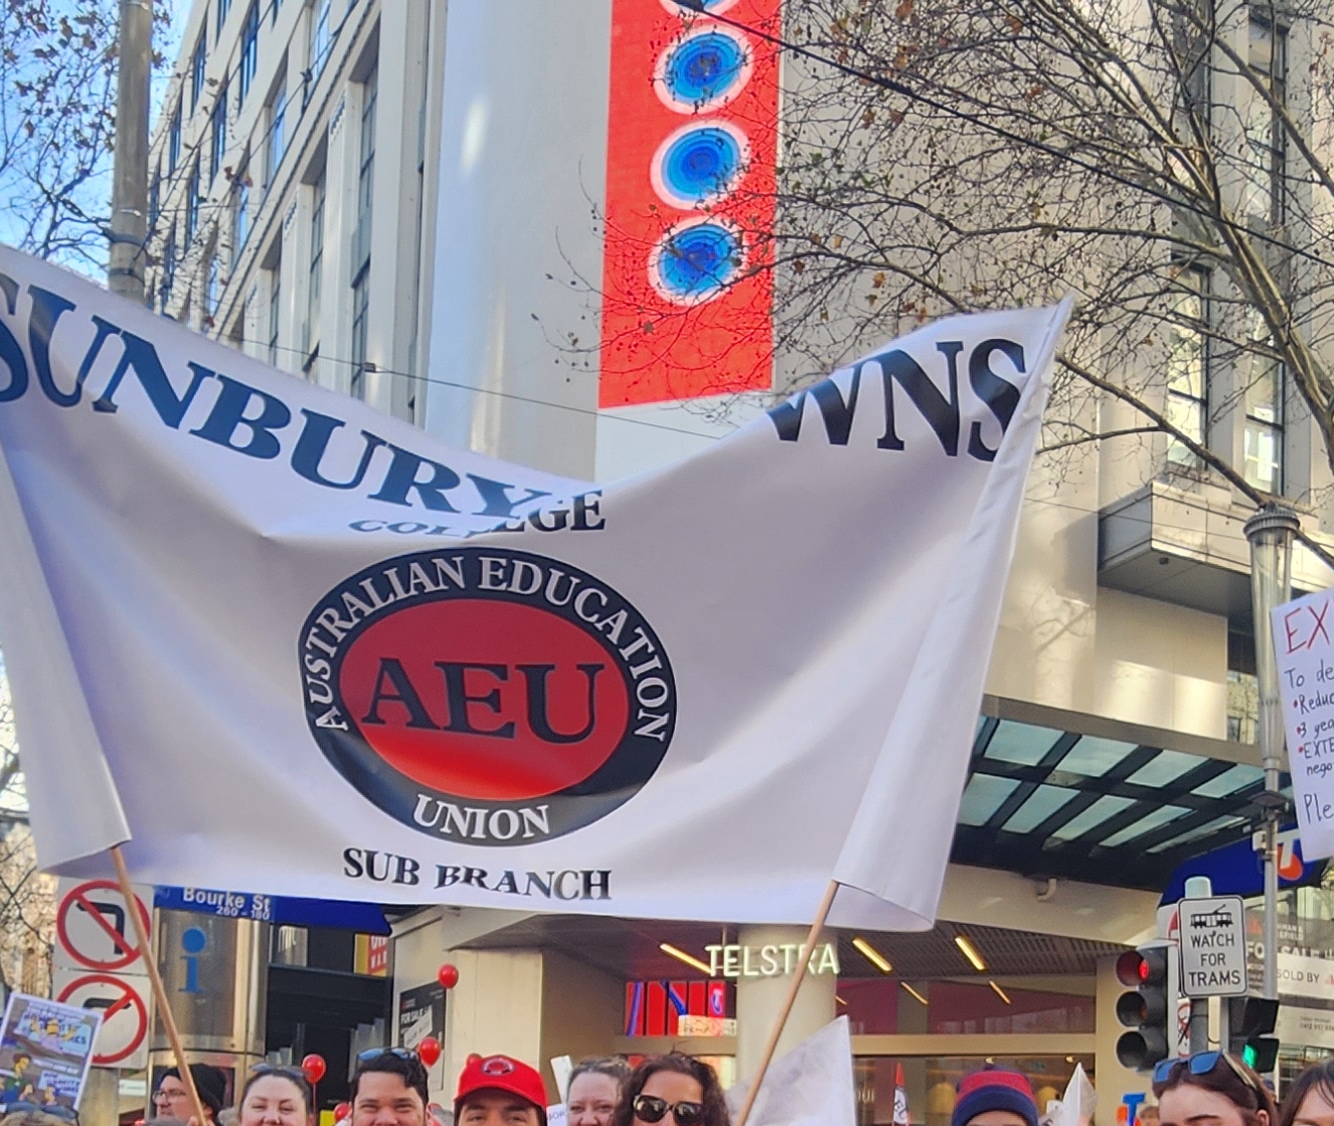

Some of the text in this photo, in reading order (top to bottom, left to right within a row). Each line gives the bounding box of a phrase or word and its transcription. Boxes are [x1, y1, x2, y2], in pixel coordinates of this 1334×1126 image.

[349, 489, 606, 538] COLGE
[309, 556, 670, 743] AUSTRALIAN EDUCATION
[1284, 668, 1305, 690] To
[363, 658, 607, 747] AEU
[412, 793, 551, 841] UNION
[343, 846, 612, 901] SUB BRANCH
[183, 888, 271, 912] Bourke St
[1190, 931, 1234, 949] WATCH
[1201, 953, 1226, 966] FOR
[1188, 970, 1241, 987] TRAMS
[1277, 970, 1304, 982] SOLD
[1307, 972, 1320, 983] BY
